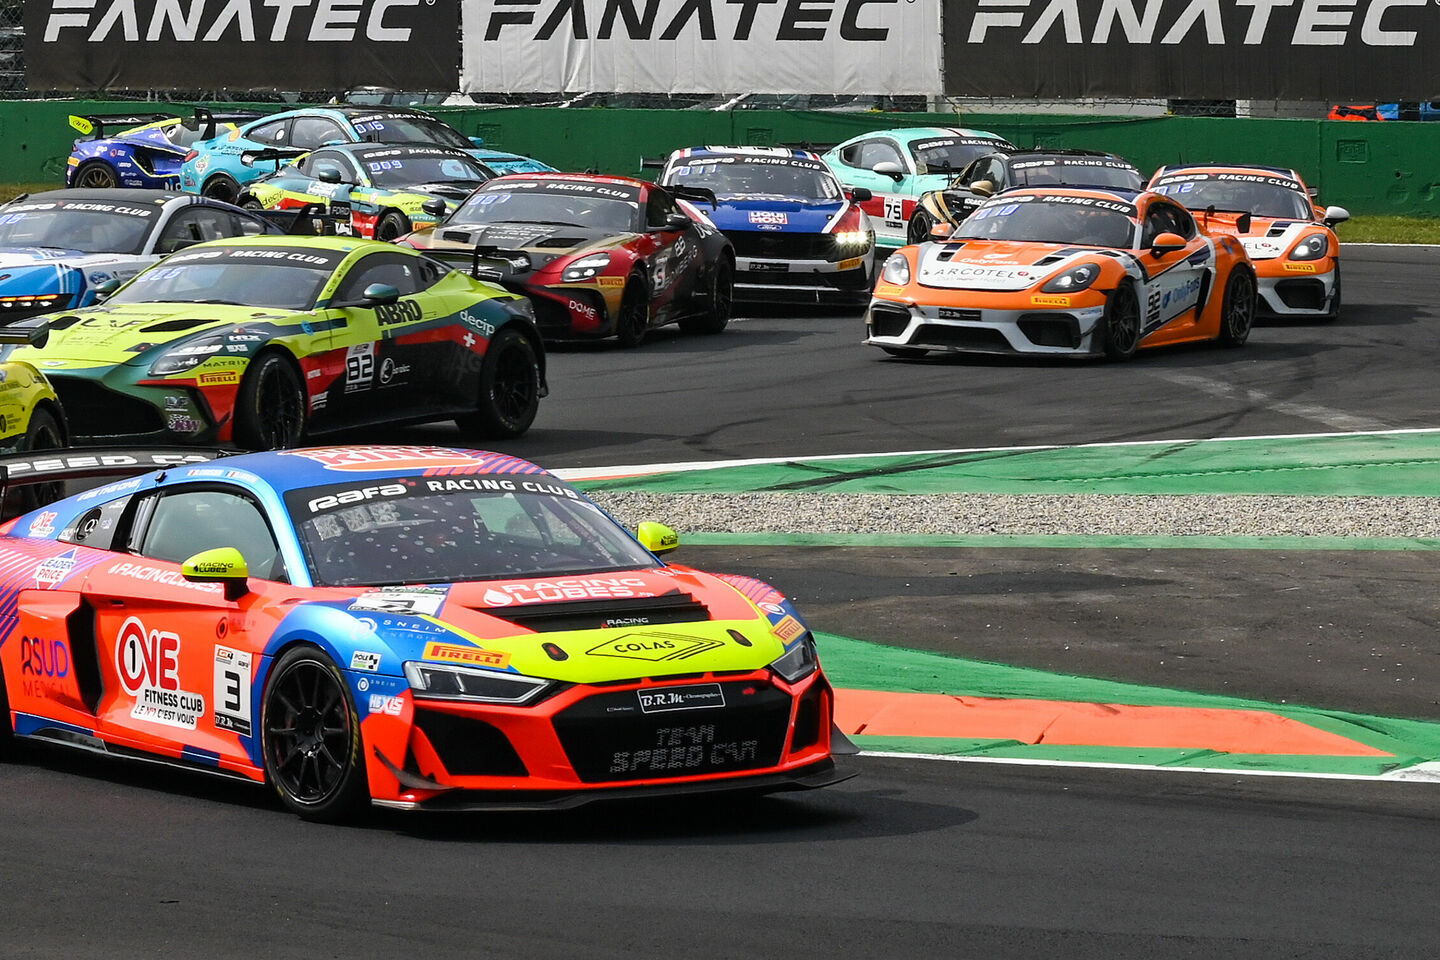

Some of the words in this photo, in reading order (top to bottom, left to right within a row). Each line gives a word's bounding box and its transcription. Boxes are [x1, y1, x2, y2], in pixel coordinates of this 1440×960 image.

[744, 157, 789, 166] RACING
[790, 159, 821, 170] CLUB
[1063, 159, 1103, 169] RACING
[1217, 174, 1264, 184] RACING
[1267, 178, 1300, 190] CLUB
[546, 182, 594, 193] RACING
[596, 187, 630, 199] CLUB
[63, 203, 114, 213] RACING
[115, 206, 152, 217] CLUB
[331, 205, 350, 216] FORD
[884, 203, 901, 220] 75
[1042, 196, 1094, 206] RACING
[1095, 200, 1132, 214] CLUB
[230, 250, 286, 260] RACING
[287, 253, 329, 265] CLUB
[934, 268, 1015, 279] ARCOTEL
[374, 299, 423, 327] ABRO
[568, 299, 597, 317] DOME
[459, 310, 496, 336] decip
[203, 359, 248, 368] MATRIX
[346, 353, 372, 382] 82
[201, 371, 237, 383] PIRELLI
[426, 478, 523, 494] RACING
[526, 480, 579, 500] CLUB
[41, 559, 74, 571] LEADER
[200, 561, 234, 569] RACING
[37, 568, 65, 581] PRICE
[501, 578, 647, 592] RACING
[514, 586, 635, 604] LUBES
[383, 619, 448, 634] SNEIM
[606, 617, 649, 626] RACING
[774, 618, 804, 642] PIRELLI
[614, 640, 676, 653] COLAS
[430, 645, 504, 665] PIRELLI
[224, 670, 241, 712] 3
[144, 688, 179, 708] FITNESS
[179, 692, 203, 713] CLUB
[368, 693, 405, 716] HEXIS
[176, 713, 195, 726] VOUS
